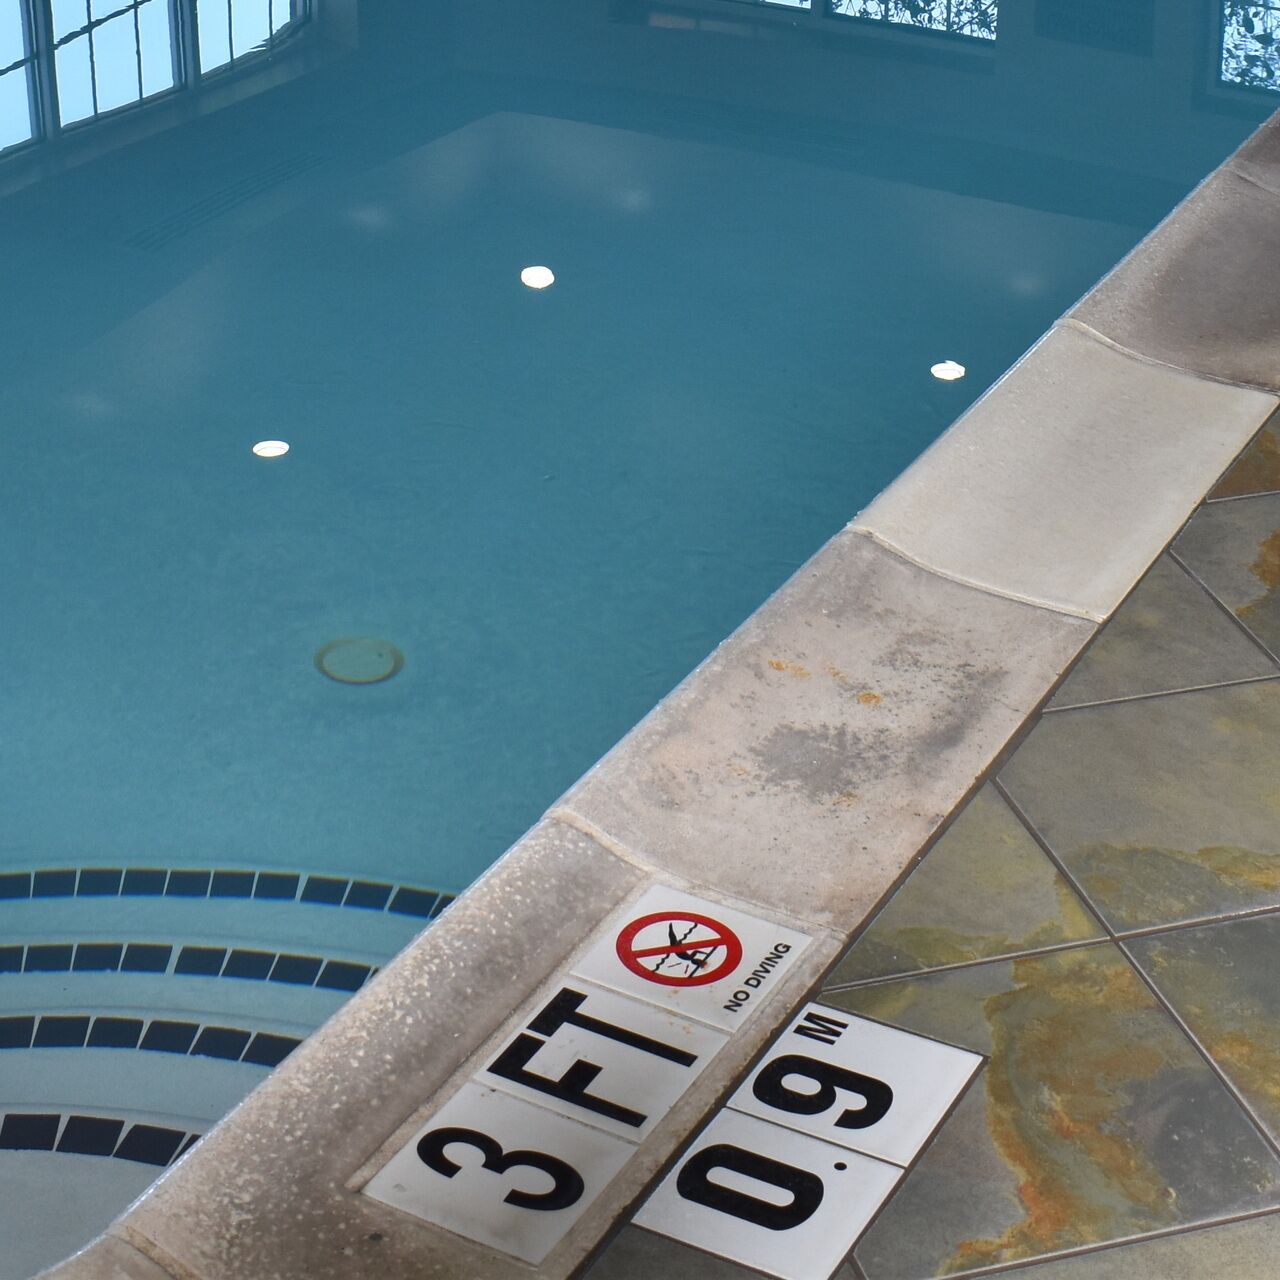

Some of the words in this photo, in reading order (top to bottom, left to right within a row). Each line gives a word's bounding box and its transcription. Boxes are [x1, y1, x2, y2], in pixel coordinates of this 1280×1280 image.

[723, 990, 750, 1012] NO
[744, 943, 792, 988] DIVING
[487, 988, 699, 1128] FT
[417, 1126, 585, 1210] 3
[676, 1054, 893, 1230] 0.9
[793, 1012, 849, 1045] M
